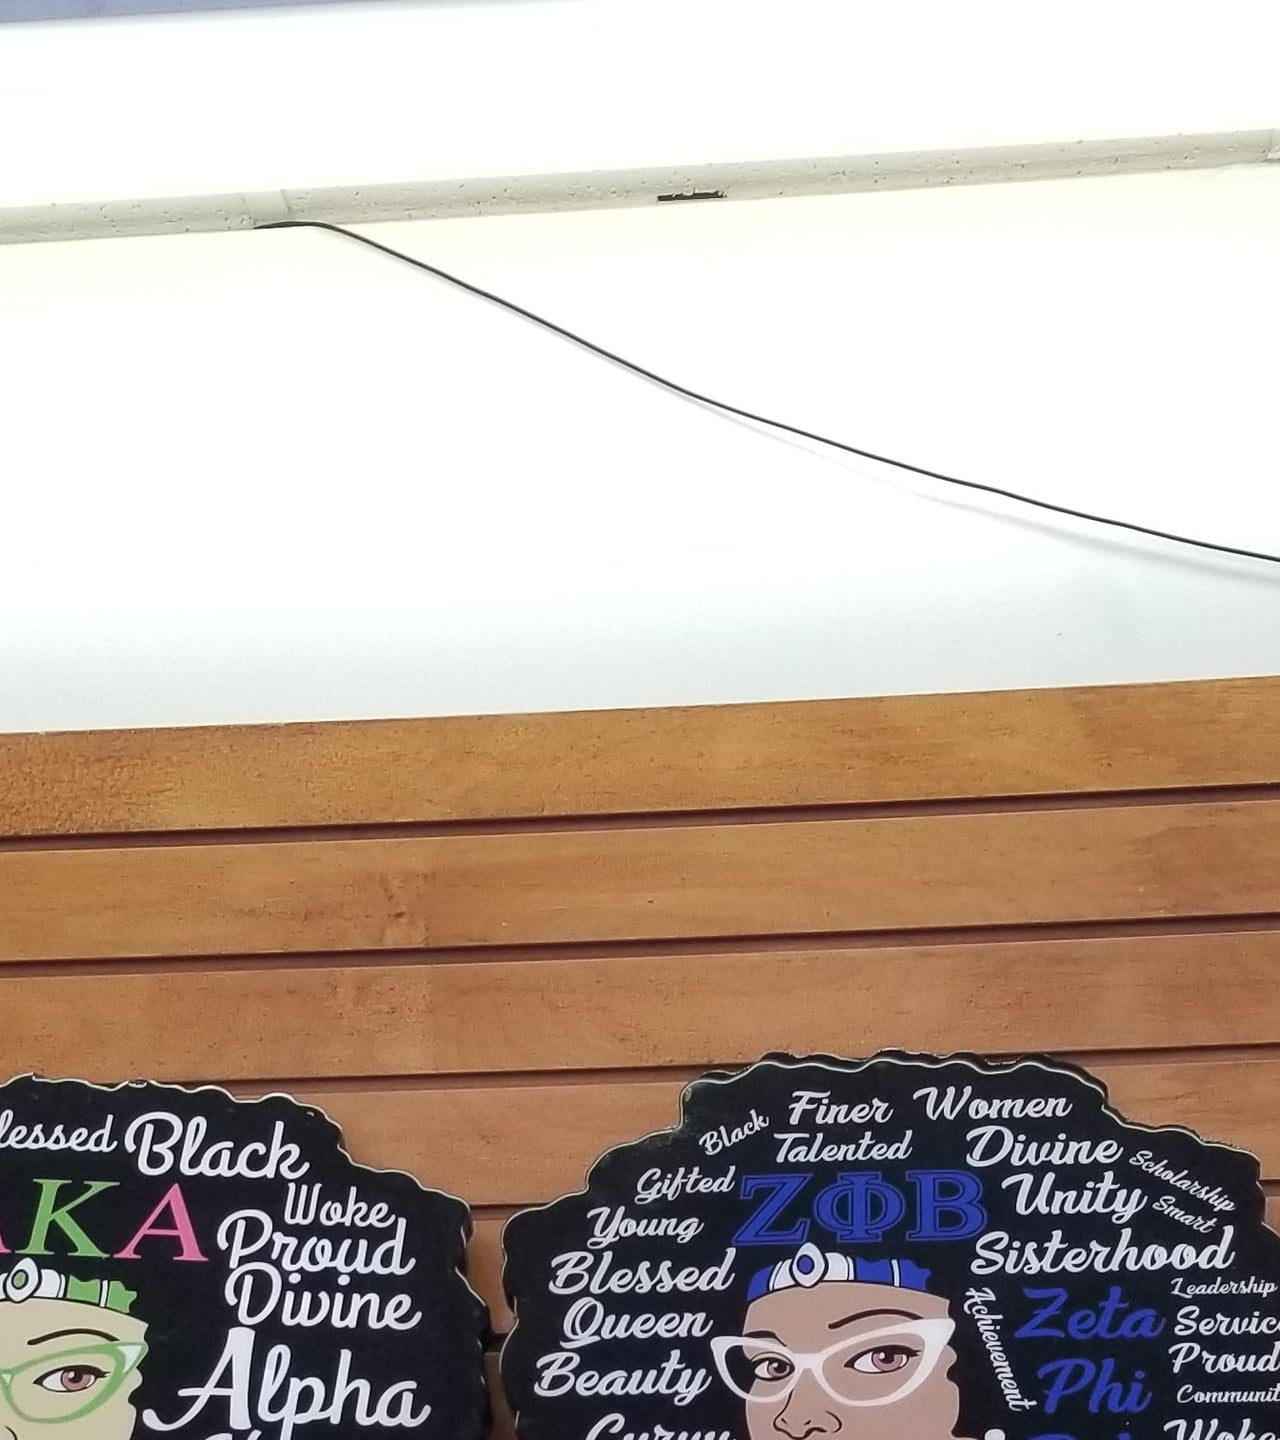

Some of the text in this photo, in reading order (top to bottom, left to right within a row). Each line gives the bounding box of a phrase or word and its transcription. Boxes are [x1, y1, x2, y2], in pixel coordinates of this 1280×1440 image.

[789, 1086, 1072, 1125] Finer Women
[125, 1112, 309, 1179] Black
[699, 1109, 769, 1155] Black
[774, 1130, 912, 1163] Talented
[966, 1126, 1123, 1167] Divine
[285, 1182, 395, 1227] Woke
[635, 1166, 735, 1204] Gifted
[1002, 1171, 1147, 1224] Unity
[1129, 1151, 1235, 1211] Scholarship
[587, 1206, 704, 1249] Young
[1153, 1196, 1217, 1233] Smart
[217, 1210, 416, 1275] Proud
[971, 1225, 1235, 1274] Sisterhood
[549, 1247, 736, 1294] Blessed
[1171, 1276, 1278, 1298] Leadership
[225, 1262, 422, 1330] Divine
[1015, 1286, 1165, 1339] Zeta
[560, 1297, 713, 1349] Queen
[964, 1288, 1037, 1411] Achievement
[534, 1350, 712, 1406] Beauty
[1038, 1358, 1151, 1413] Phi
